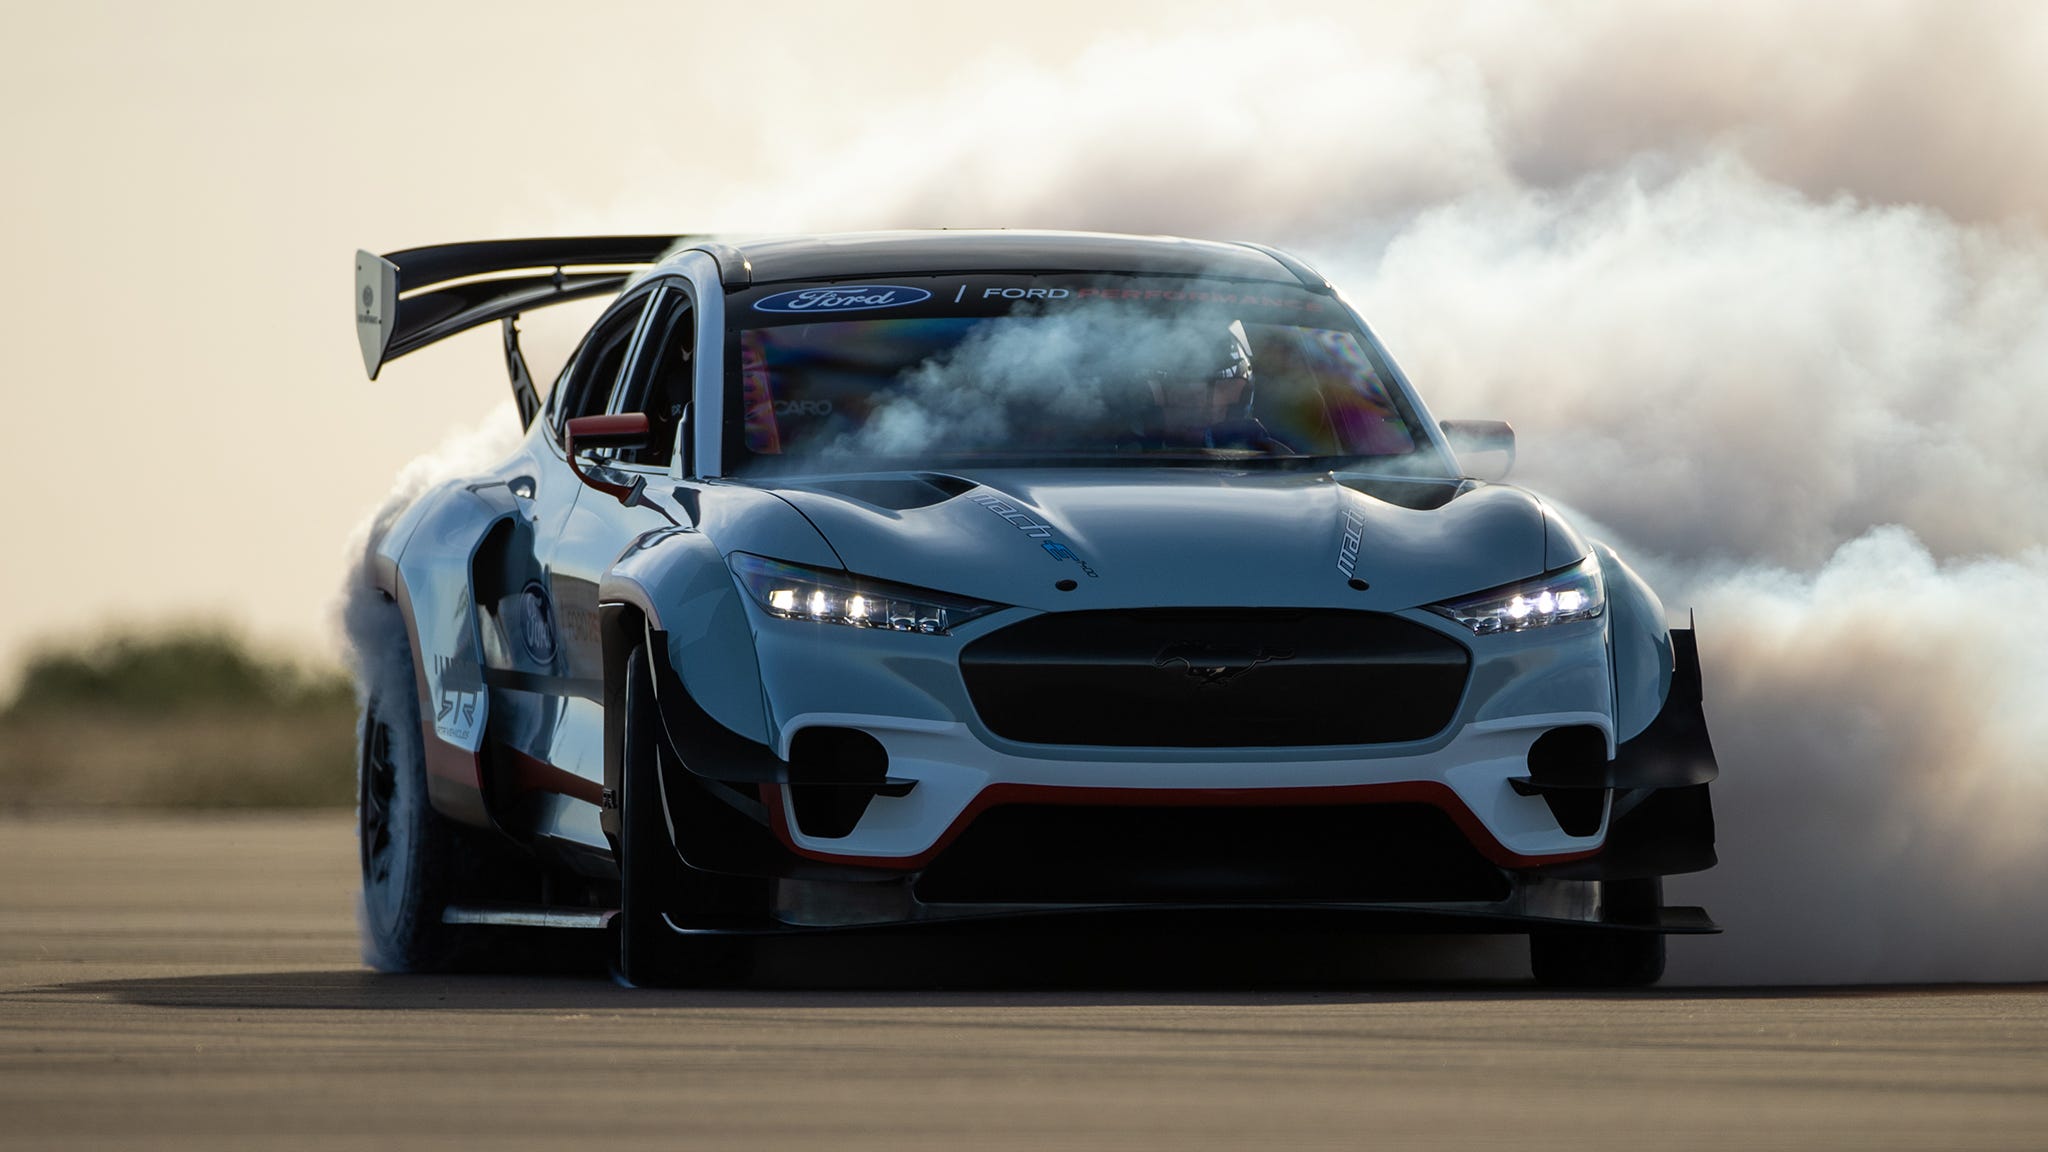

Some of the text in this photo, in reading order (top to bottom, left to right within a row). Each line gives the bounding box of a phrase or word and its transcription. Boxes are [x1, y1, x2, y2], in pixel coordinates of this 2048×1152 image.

[788, 287, 896, 310] Ford
[983, 287, 1323, 312] FORD PERFORMANCE
